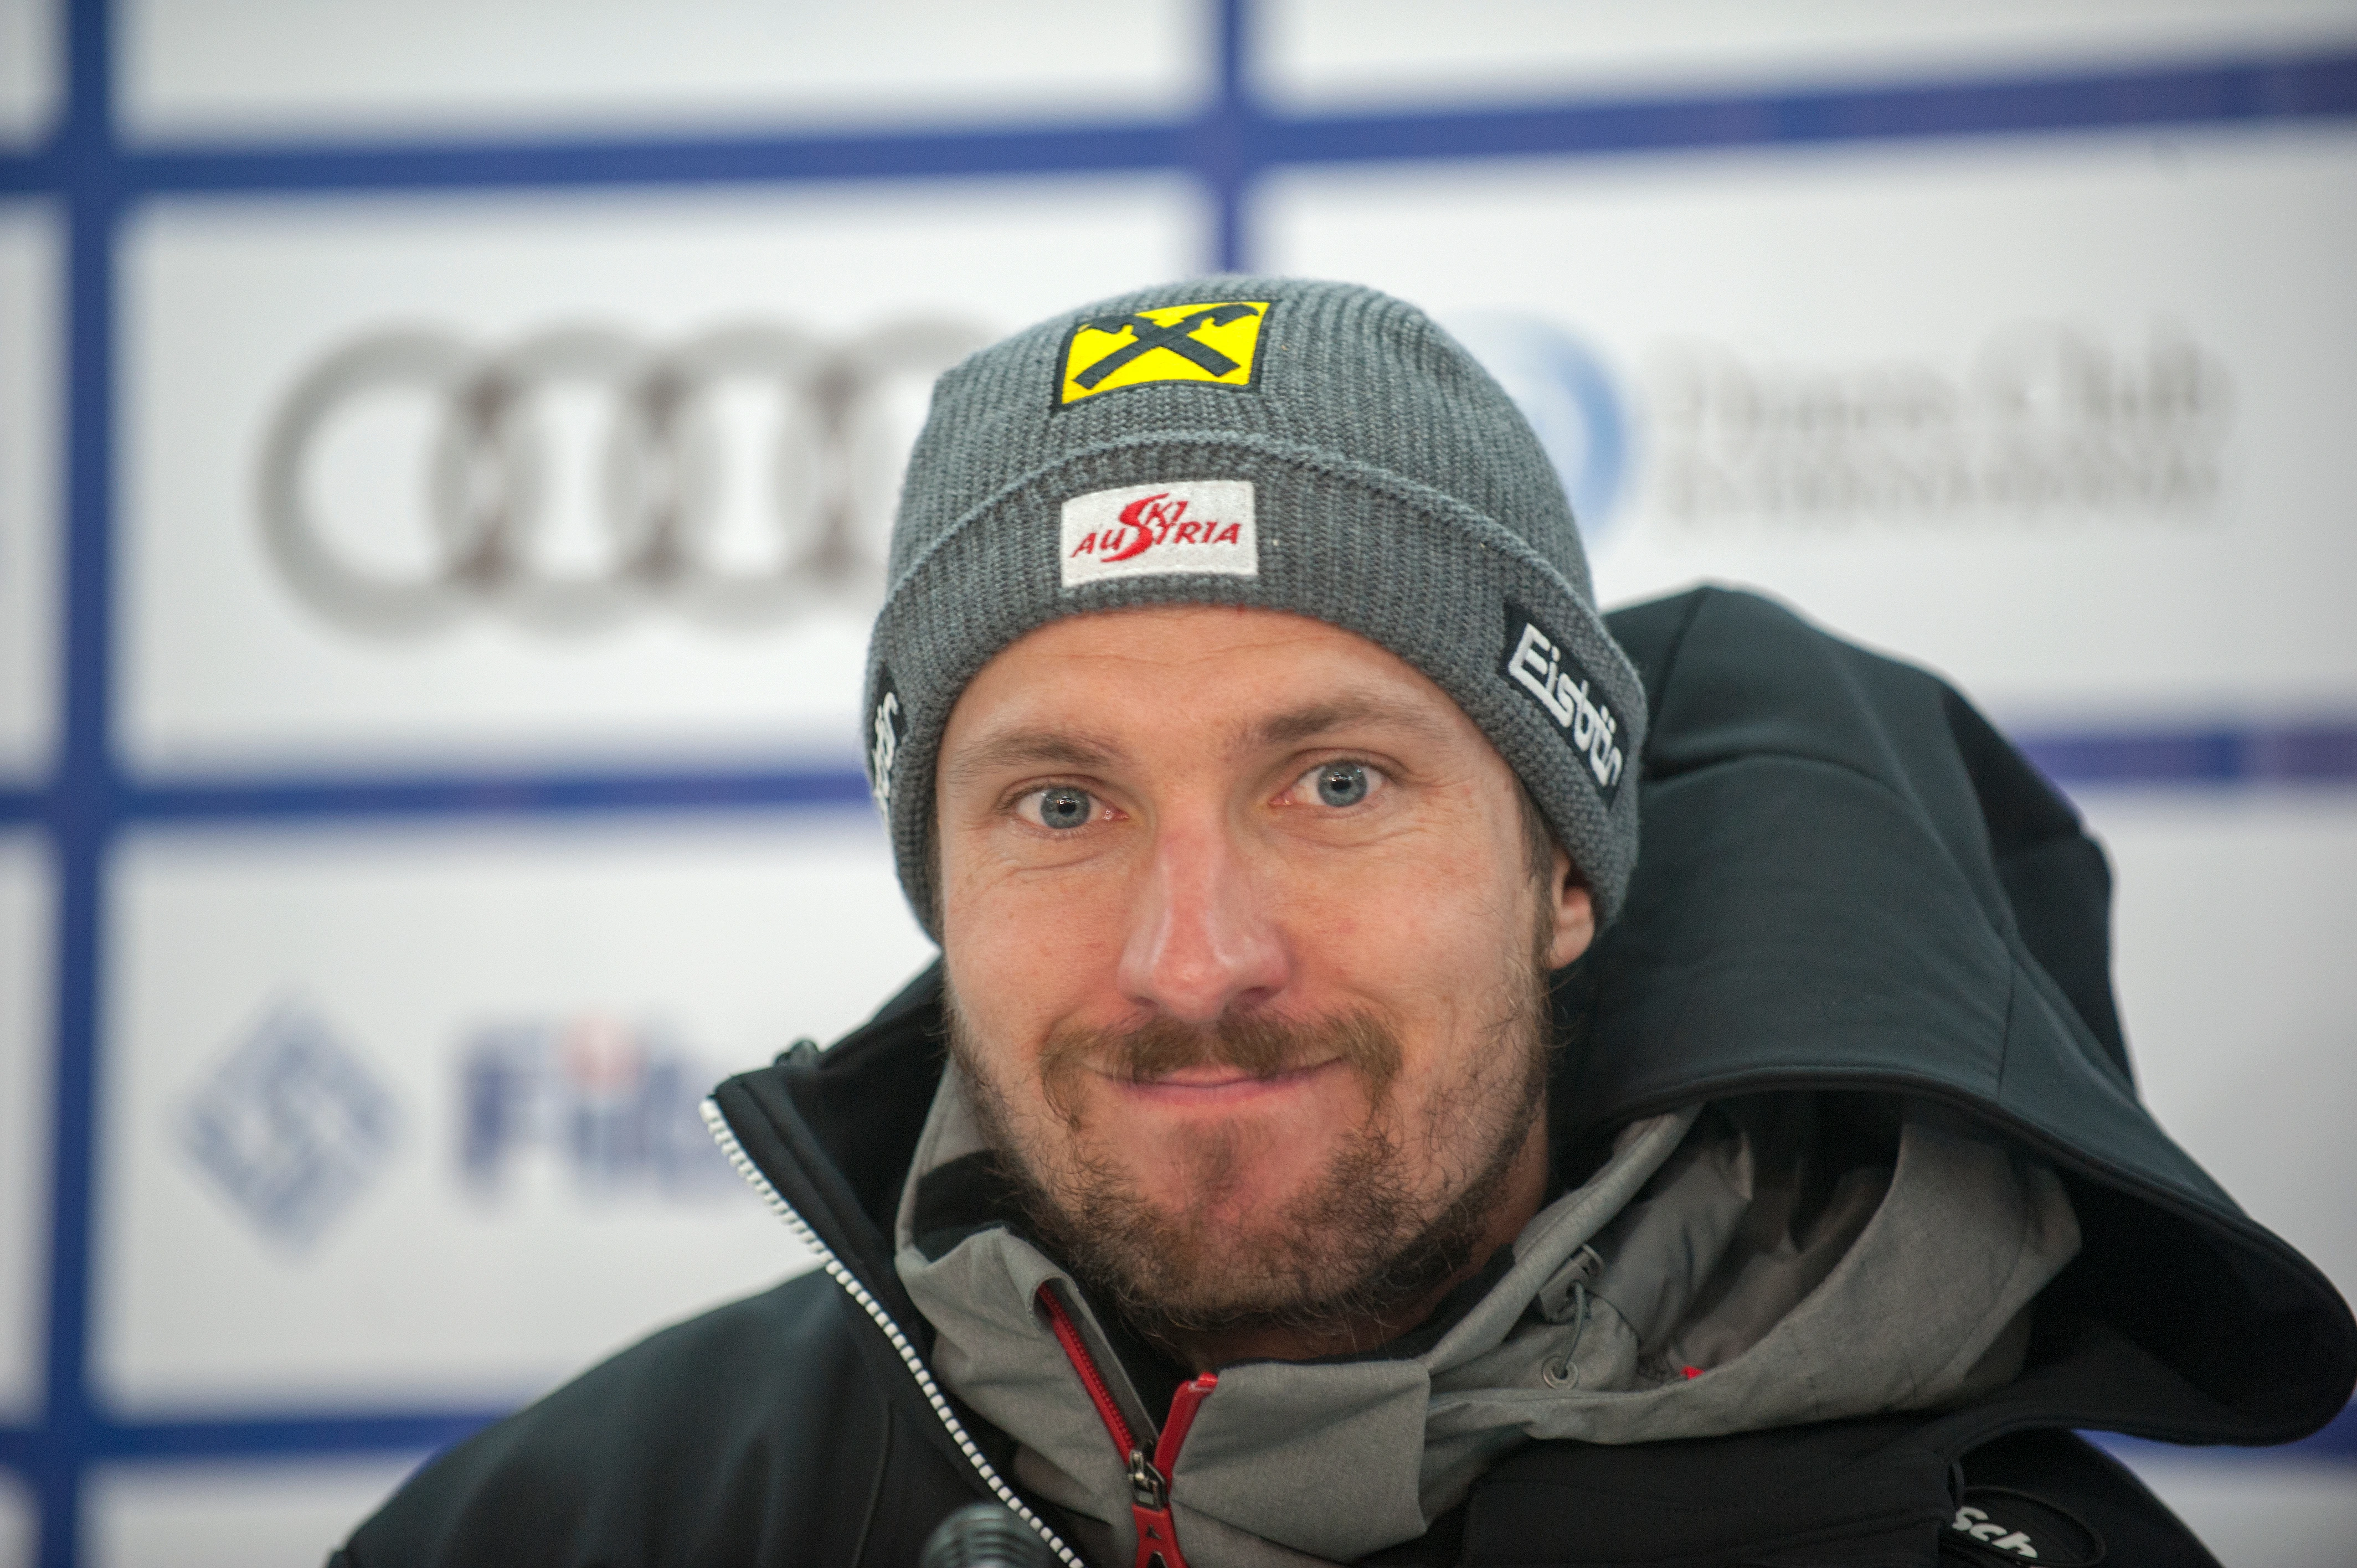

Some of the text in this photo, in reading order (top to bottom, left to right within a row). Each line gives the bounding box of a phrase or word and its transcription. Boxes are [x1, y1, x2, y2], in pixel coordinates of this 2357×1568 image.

[1071, 493, 1241, 563] AUSTRIA
[1100, 493, 1188, 563] SKI
[1507, 622, 1623, 787] Eisbär
